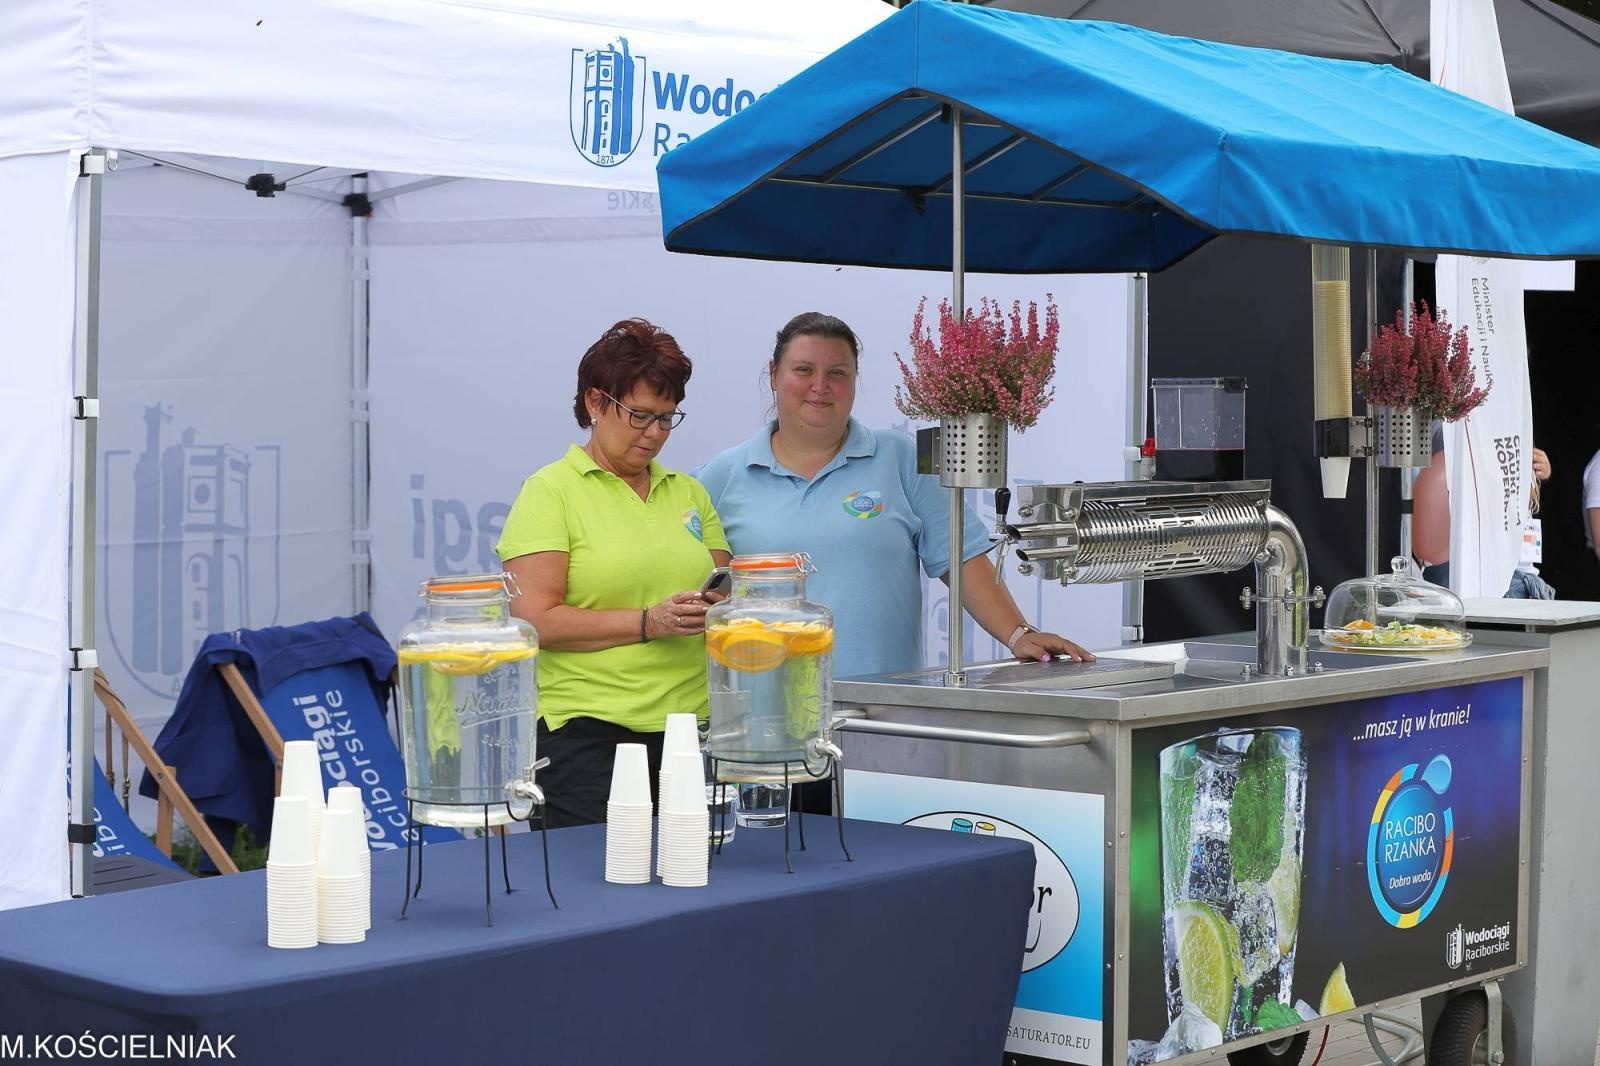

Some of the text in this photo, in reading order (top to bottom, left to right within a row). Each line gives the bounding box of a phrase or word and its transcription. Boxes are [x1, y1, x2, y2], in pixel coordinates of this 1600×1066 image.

[1471, 277, 1487, 335] Edukacji
[1481, 277, 1495, 335] Minister
[1504, 436, 1516, 494] NAUKI
[1494, 438, 1510, 531] KOPERN
[1398, 713, 1413, 739] ją
[1415, 715, 1427, 731] w
[1428, 703, 1471, 729] kranie!
[326, 689, 428, 847] aciborskie
[1385, 812, 1436, 840] RACIBO
[1385, 835, 1436, 863] RZANKA
[1389, 868, 1432, 889] Dobra woda
[1465, 921, 1510, 946] Wodociągi
[1465, 939, 1510, 961] Raciborskie
